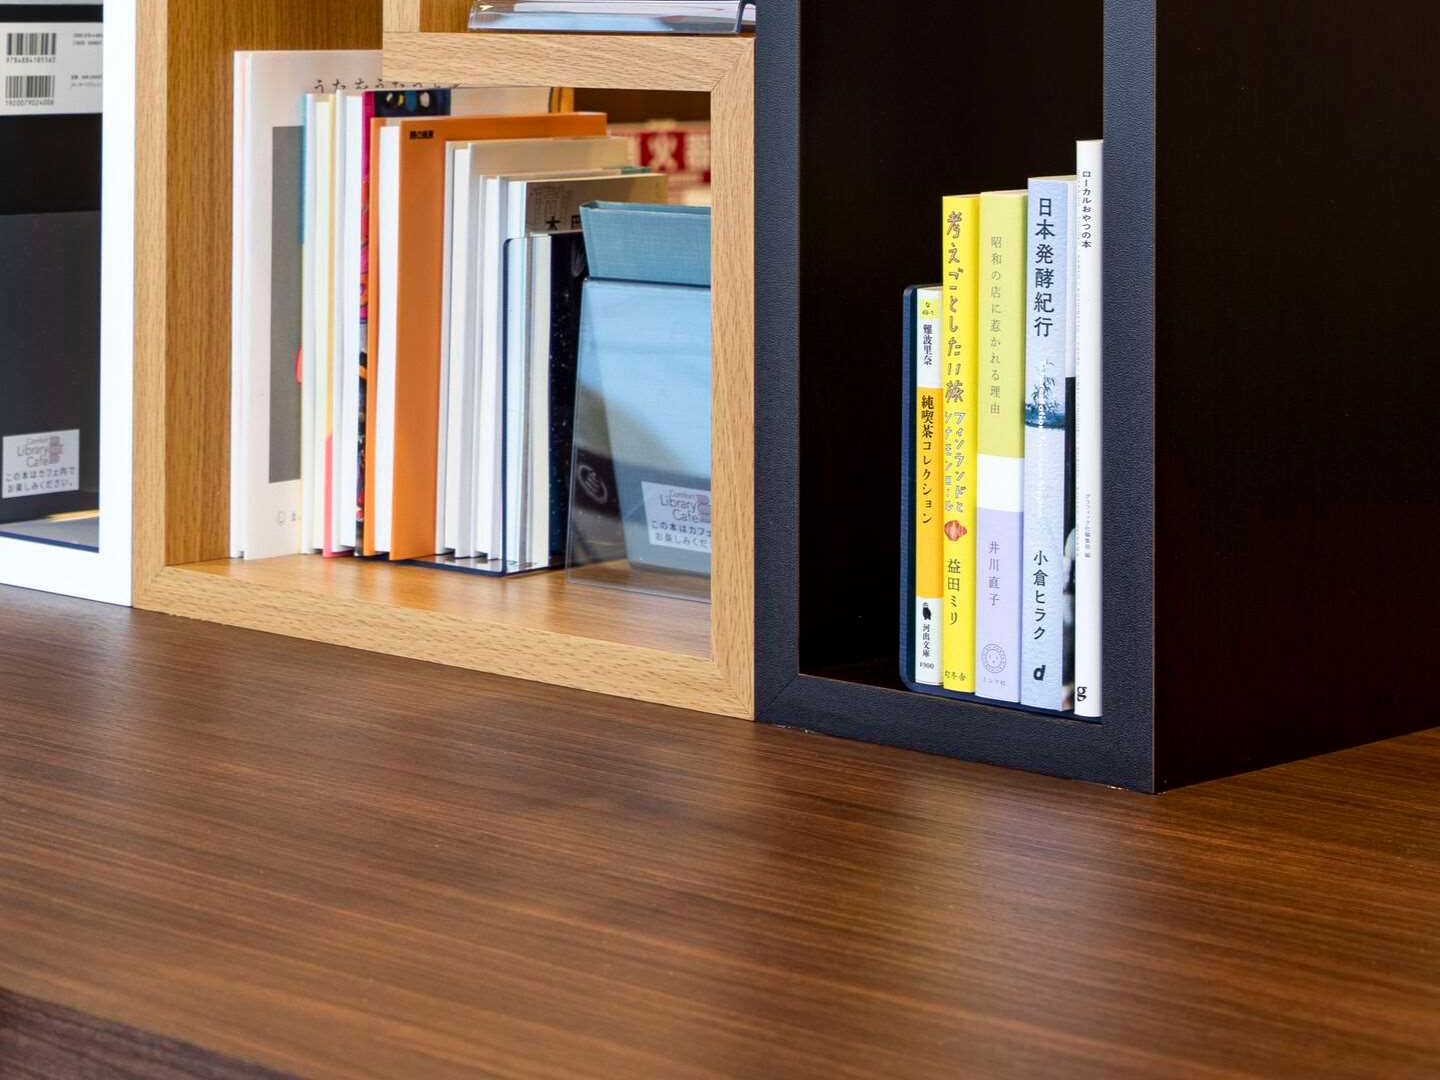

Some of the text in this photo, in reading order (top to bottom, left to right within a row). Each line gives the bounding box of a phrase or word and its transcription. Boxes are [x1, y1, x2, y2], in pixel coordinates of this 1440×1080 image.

[1081, 170, 1093, 249] ローカルおやつの本
[944, 210, 965, 404] 考えごとしたい旅
[1033, 197, 1056, 338] 日本発酵紀行
[922, 323, 934, 366] 難波里奈
[990, 235, 1003, 415] 昭和の店に惹かれる理由
[920, 394, 935, 524] 純喫茶コレクション
[953, 411, 967, 513] フィンランドと
[947, 558, 961, 626] 益田ミリ
[988, 540, 1001, 607] 井川直子
[1033, 549, 1049, 641] 小倉ヒラク
[922, 623, 931, 659] 河出文庫
[1076, 685, 1087, 702] g
